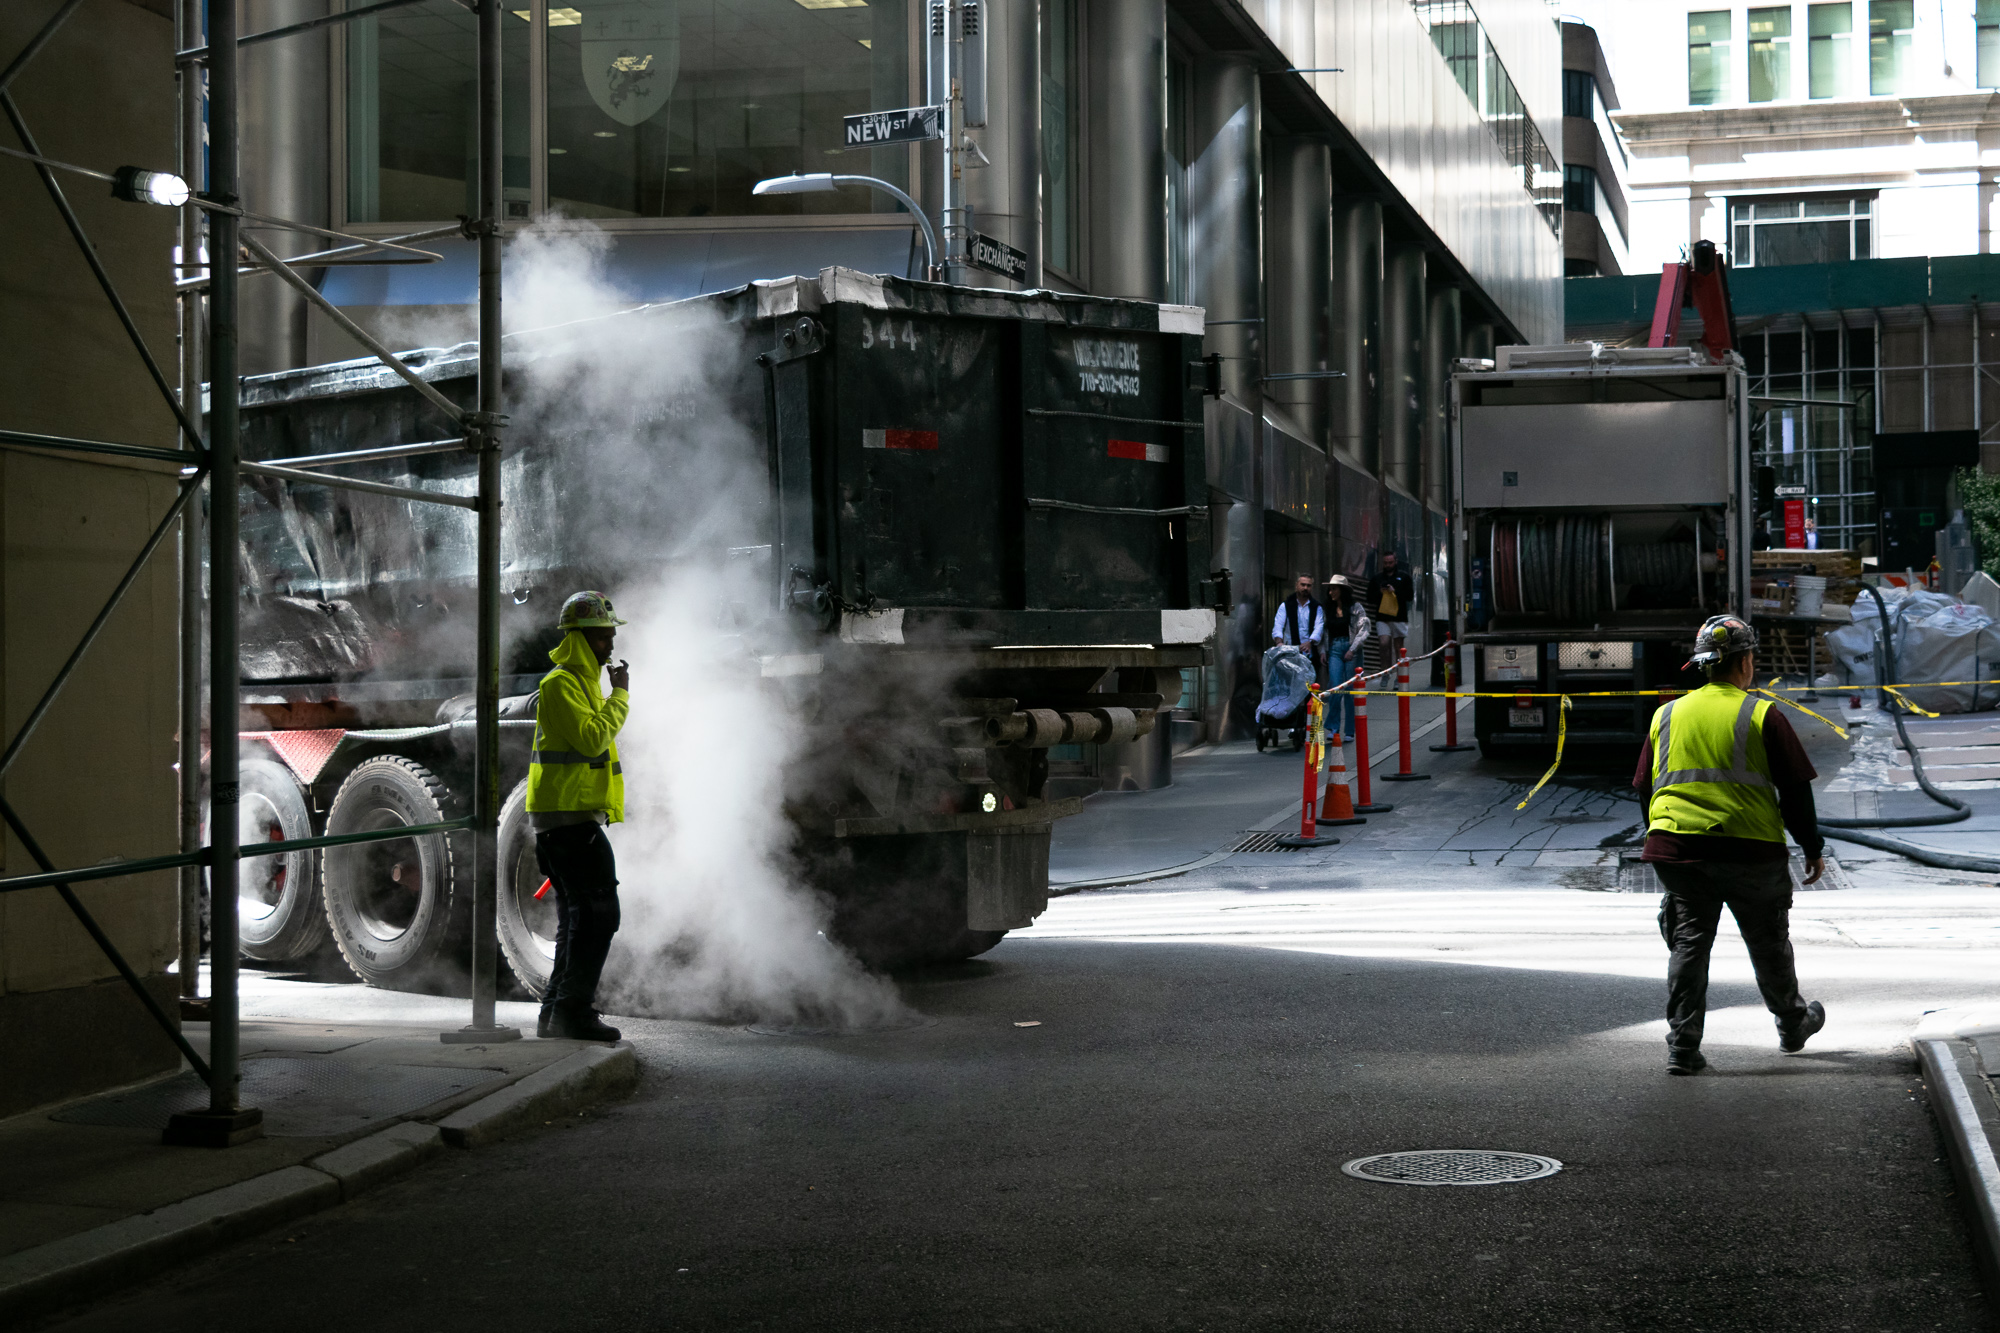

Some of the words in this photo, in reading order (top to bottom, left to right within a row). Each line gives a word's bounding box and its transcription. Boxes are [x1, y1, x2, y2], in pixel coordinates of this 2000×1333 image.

[868, 113, 889, 124] 30-81
[847, 120, 892, 143] NEW
[893, 119, 907, 130] ST
[978, 242, 1015, 274] EXCHANGE
[1014, 257, 1027, 271] PLACE
[1079, 372, 1140, 397] 718-302-4503
